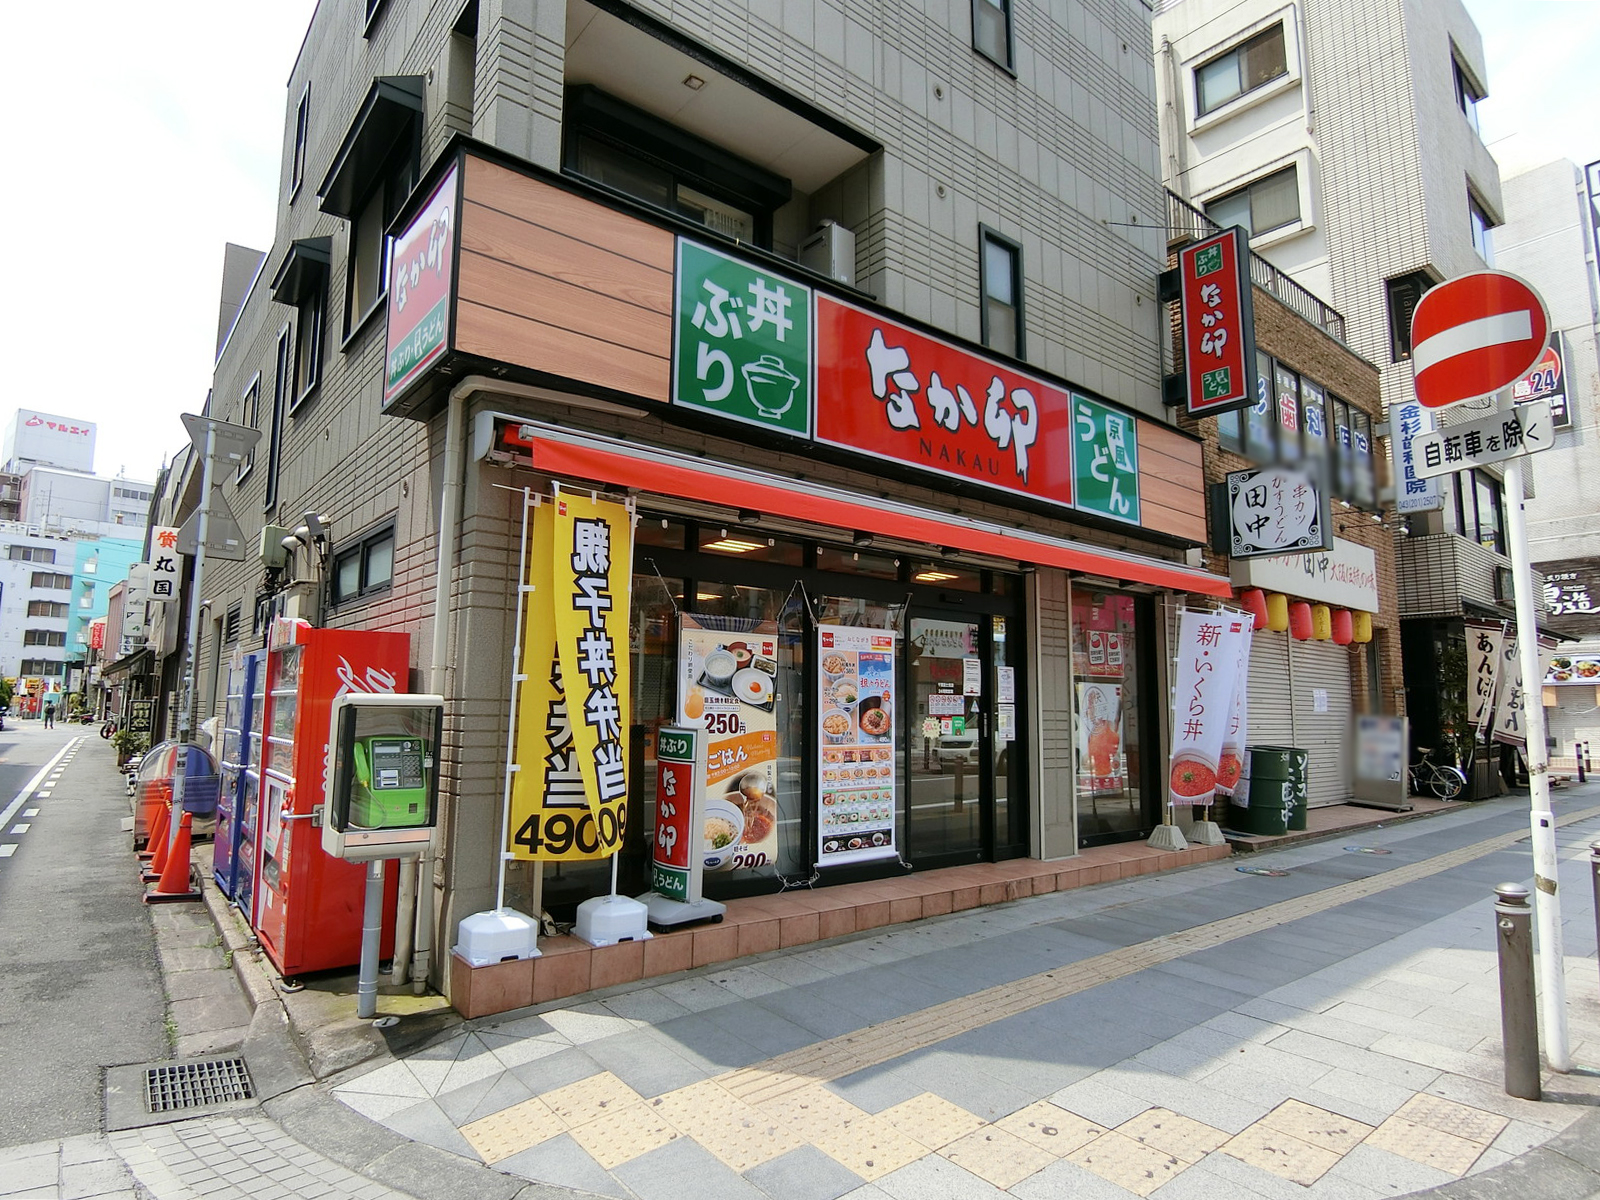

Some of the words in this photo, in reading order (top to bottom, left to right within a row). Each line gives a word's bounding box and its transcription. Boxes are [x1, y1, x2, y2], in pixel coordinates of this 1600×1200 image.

[395, 206, 450, 313] なか卯
[1200, 283, 1228, 360] なか卯
[46, 421, 90, 436] マルエイ
[865, 328, 1039, 487] なか卯
[918, 437, 1000, 478] NAKAU
[1076, 403, 1131, 515] うどん
[1108, 419, 1128, 468] 京風
[1424, 419, 1540, 468] 自転車を除く
[1244, 485, 1270, 540] 田中
[1292, 484, 1308, 526] 串カツ
[156, 530, 178, 549] 質
[153, 556, 176, 596] 丸国
[1183, 622, 1223, 742] 新・いくら丼
[660, 737, 687, 754] 丼ぶり
[1296, 753, 1308, 798] ソース
[658, 767, 677, 859] なか卯
[659, 873, 684, 891] うどん
